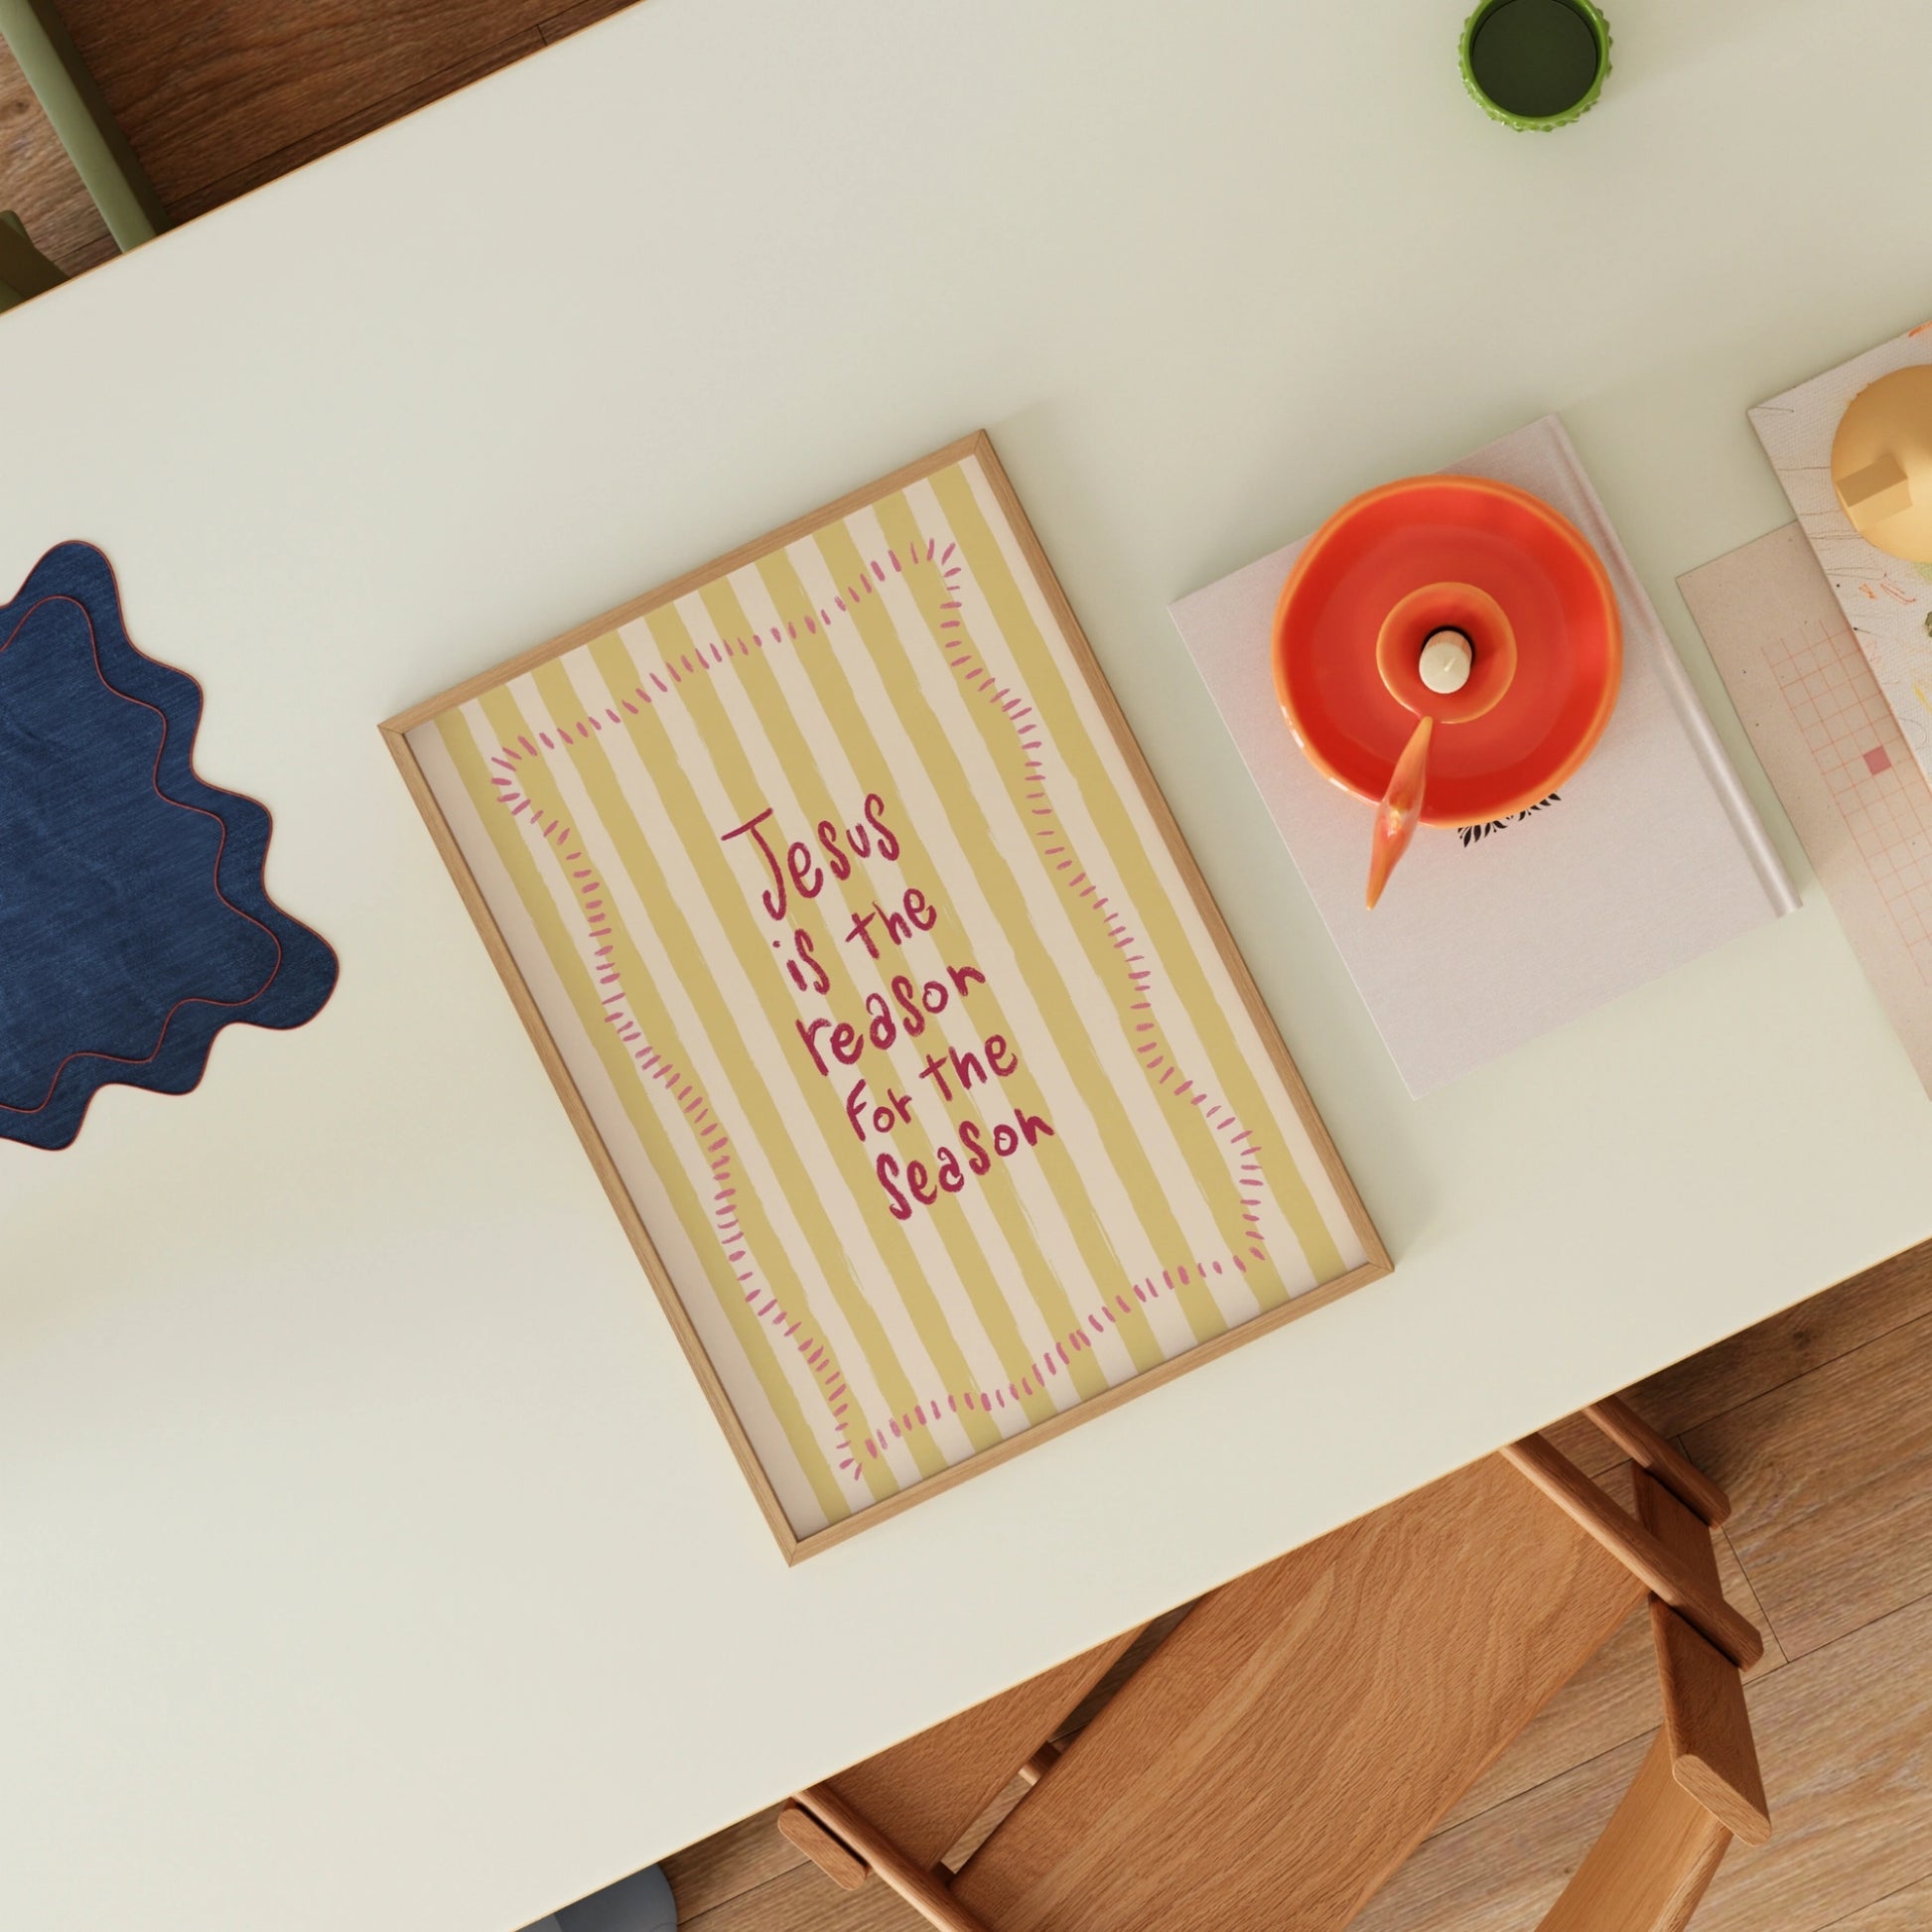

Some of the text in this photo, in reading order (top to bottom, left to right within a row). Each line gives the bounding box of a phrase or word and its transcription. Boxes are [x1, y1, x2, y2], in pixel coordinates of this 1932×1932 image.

[722, 792, 899, 920] Jesus
[772, 888, 937, 994] is the
[795, 966, 985, 1075] reason
[919, 1034, 1018, 1101] the
